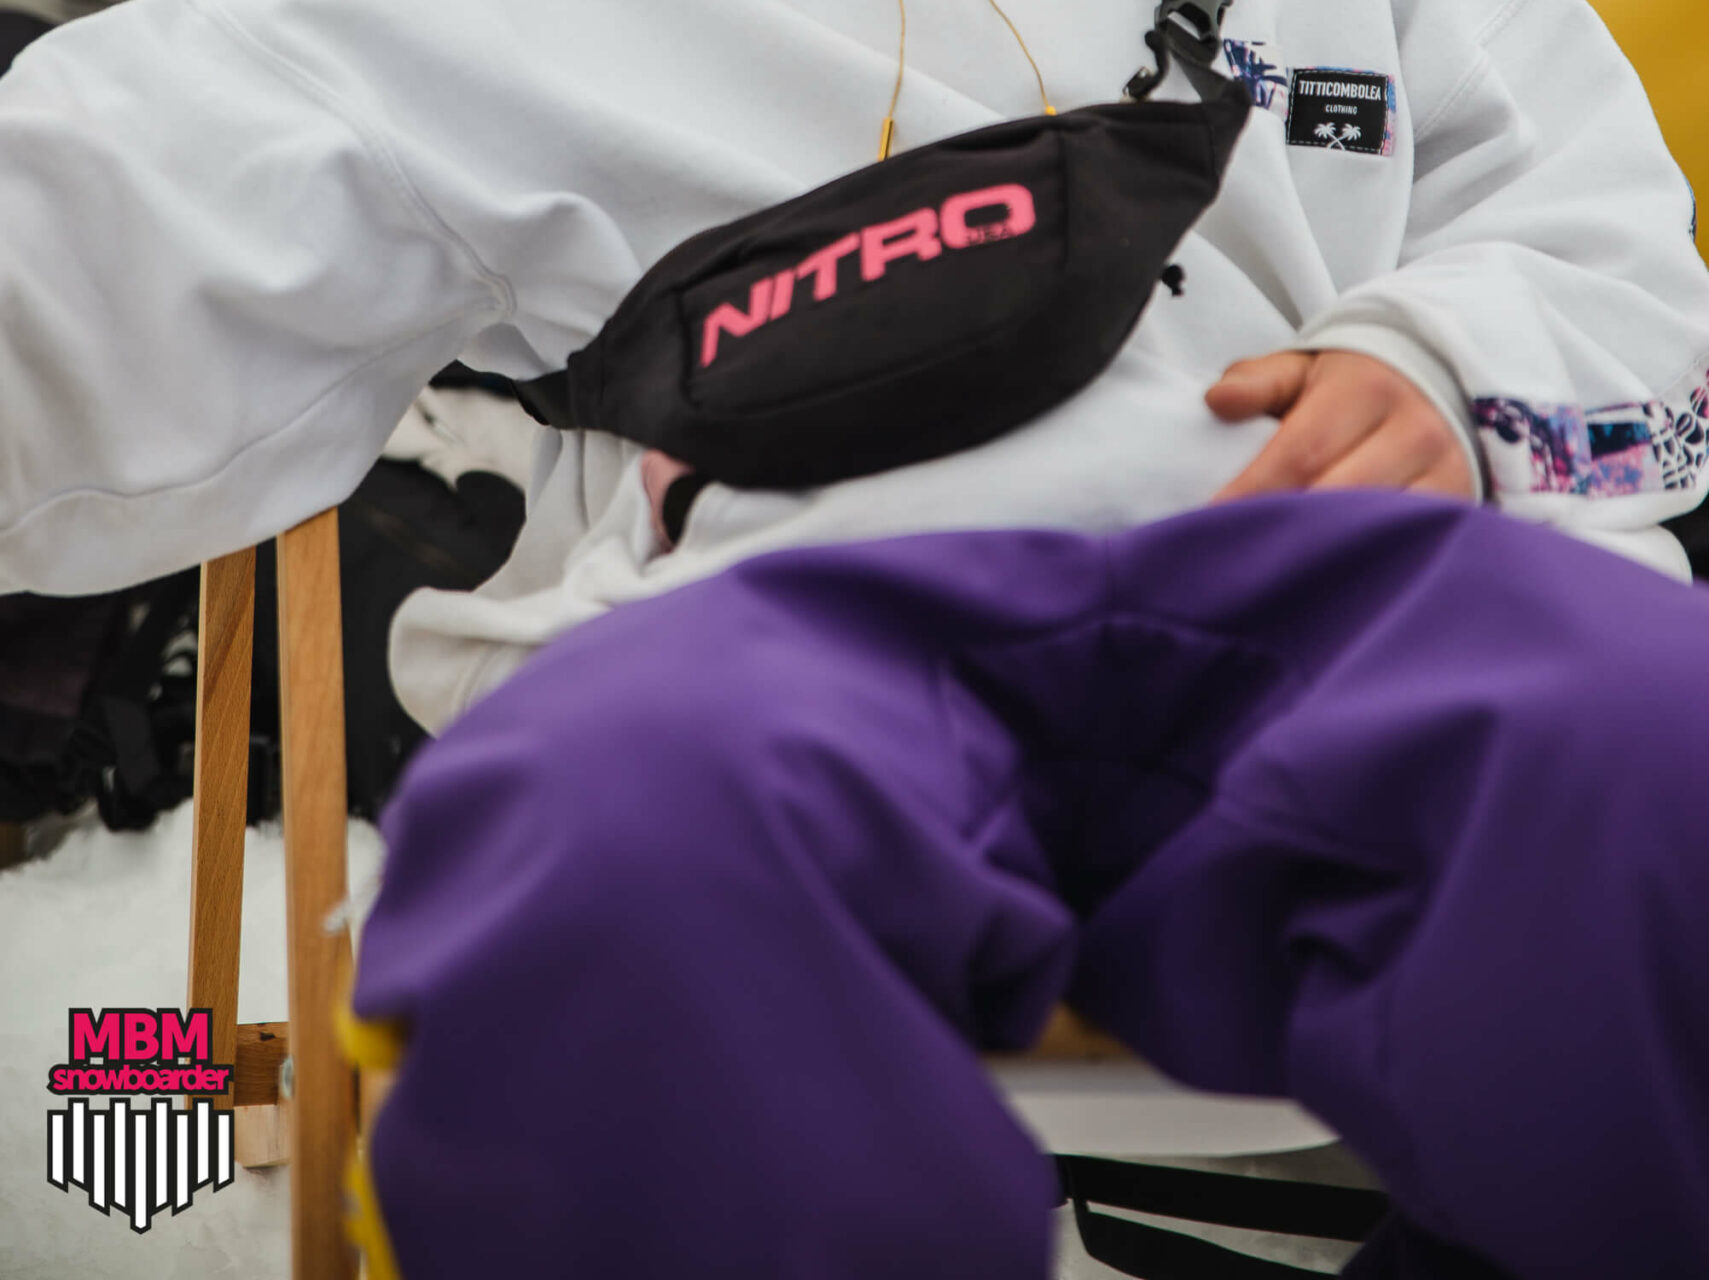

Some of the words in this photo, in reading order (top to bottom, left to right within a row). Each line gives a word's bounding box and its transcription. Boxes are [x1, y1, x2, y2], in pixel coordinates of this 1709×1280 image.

[1299, 80, 1382, 101] TITTICOMBOLEA
[1325, 104, 1358, 115] CLOTHING
[700, 183, 1036, 367] NITRO
